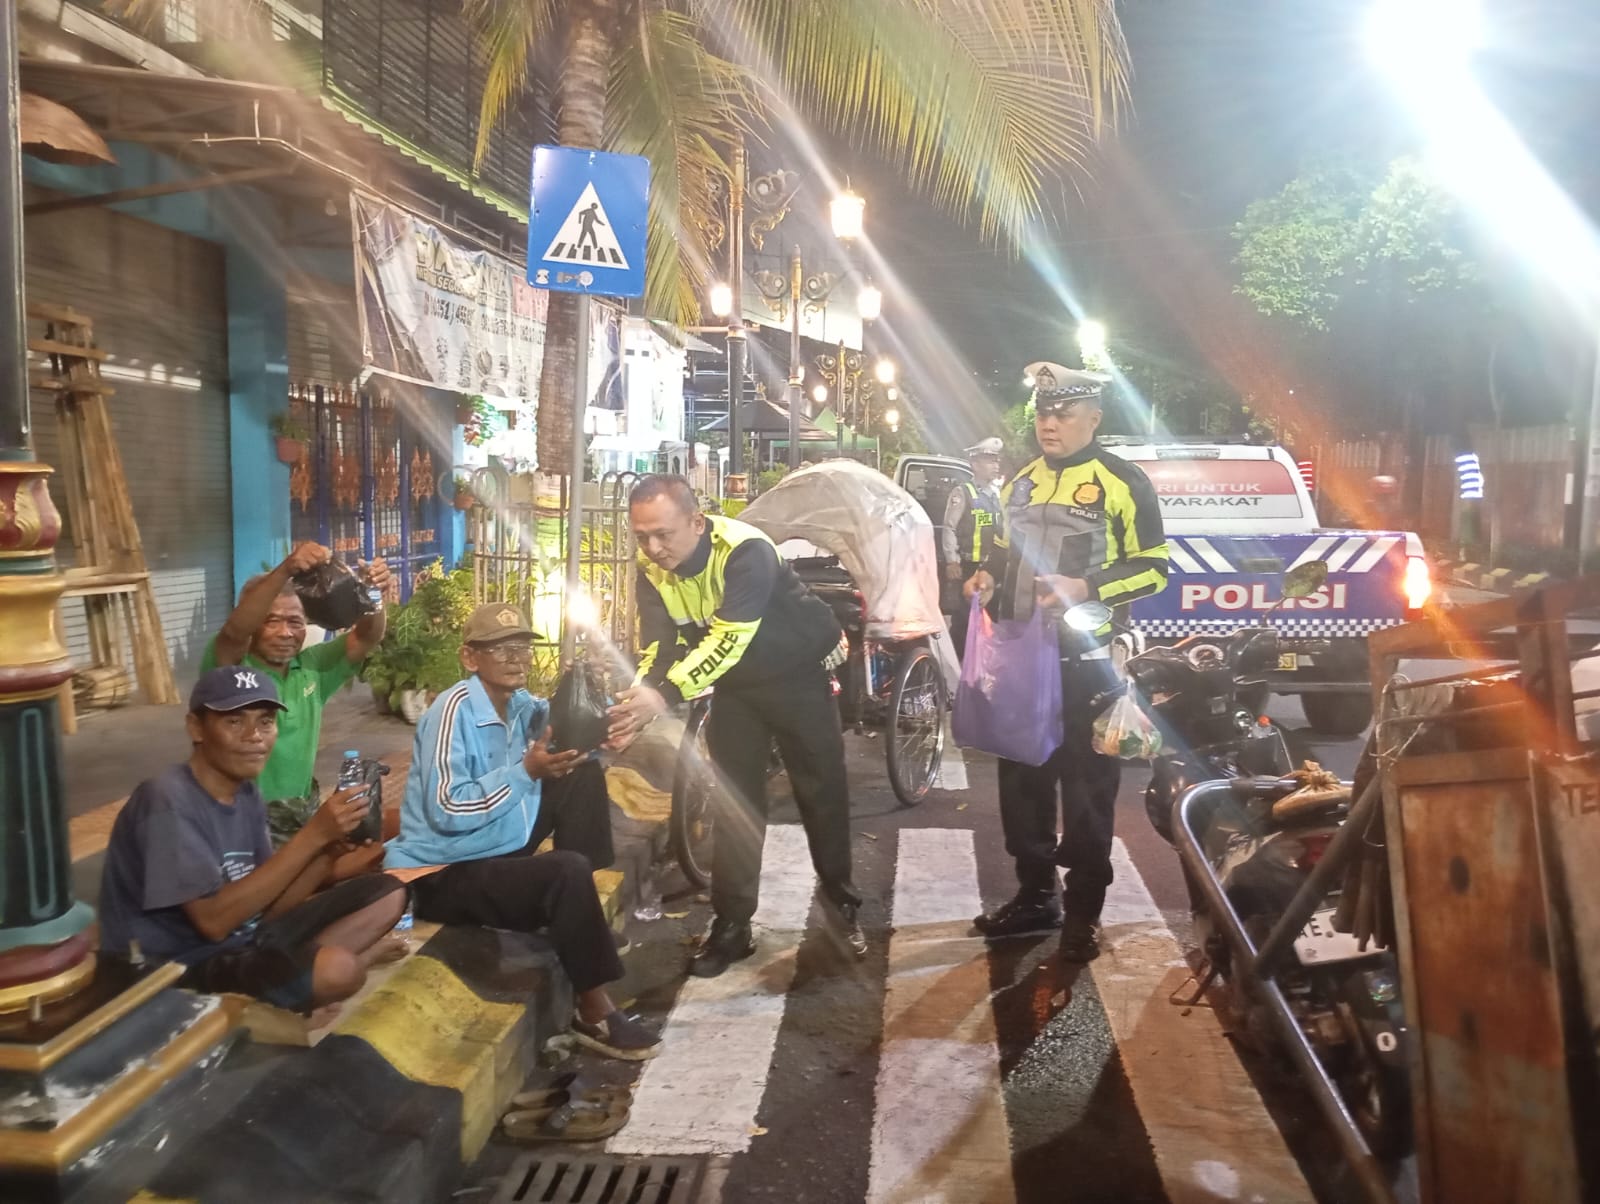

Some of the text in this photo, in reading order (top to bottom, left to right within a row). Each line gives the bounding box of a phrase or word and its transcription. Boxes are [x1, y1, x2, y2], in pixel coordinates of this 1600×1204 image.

[1184, 482, 1262, 493] UNTUK
[1160, 496, 1263, 507] YARAKAT
[688, 632, 739, 685] POLICE
[234, 672, 260, 689] NY
